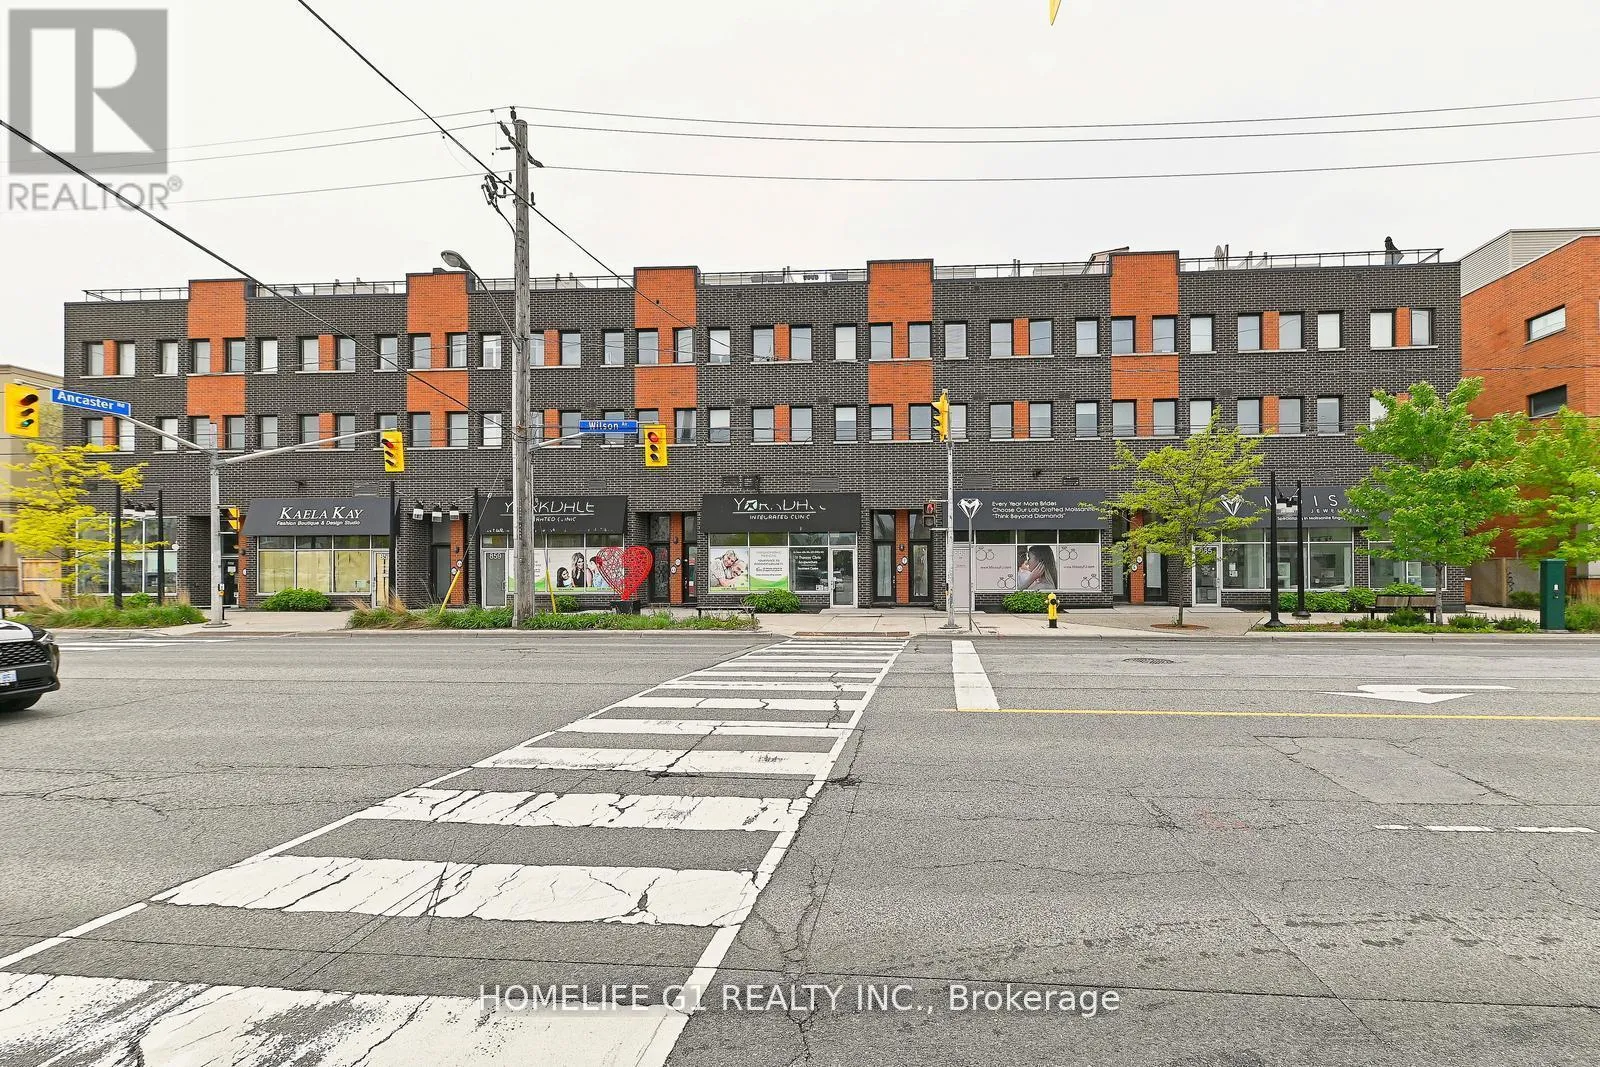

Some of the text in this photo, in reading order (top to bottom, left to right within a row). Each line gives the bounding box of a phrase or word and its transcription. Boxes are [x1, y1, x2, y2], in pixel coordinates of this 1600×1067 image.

[57, 391, 114, 409] Ancaster
[589, 421, 619, 430] Wilson
[279, 506, 364, 520] KAELA KAY
